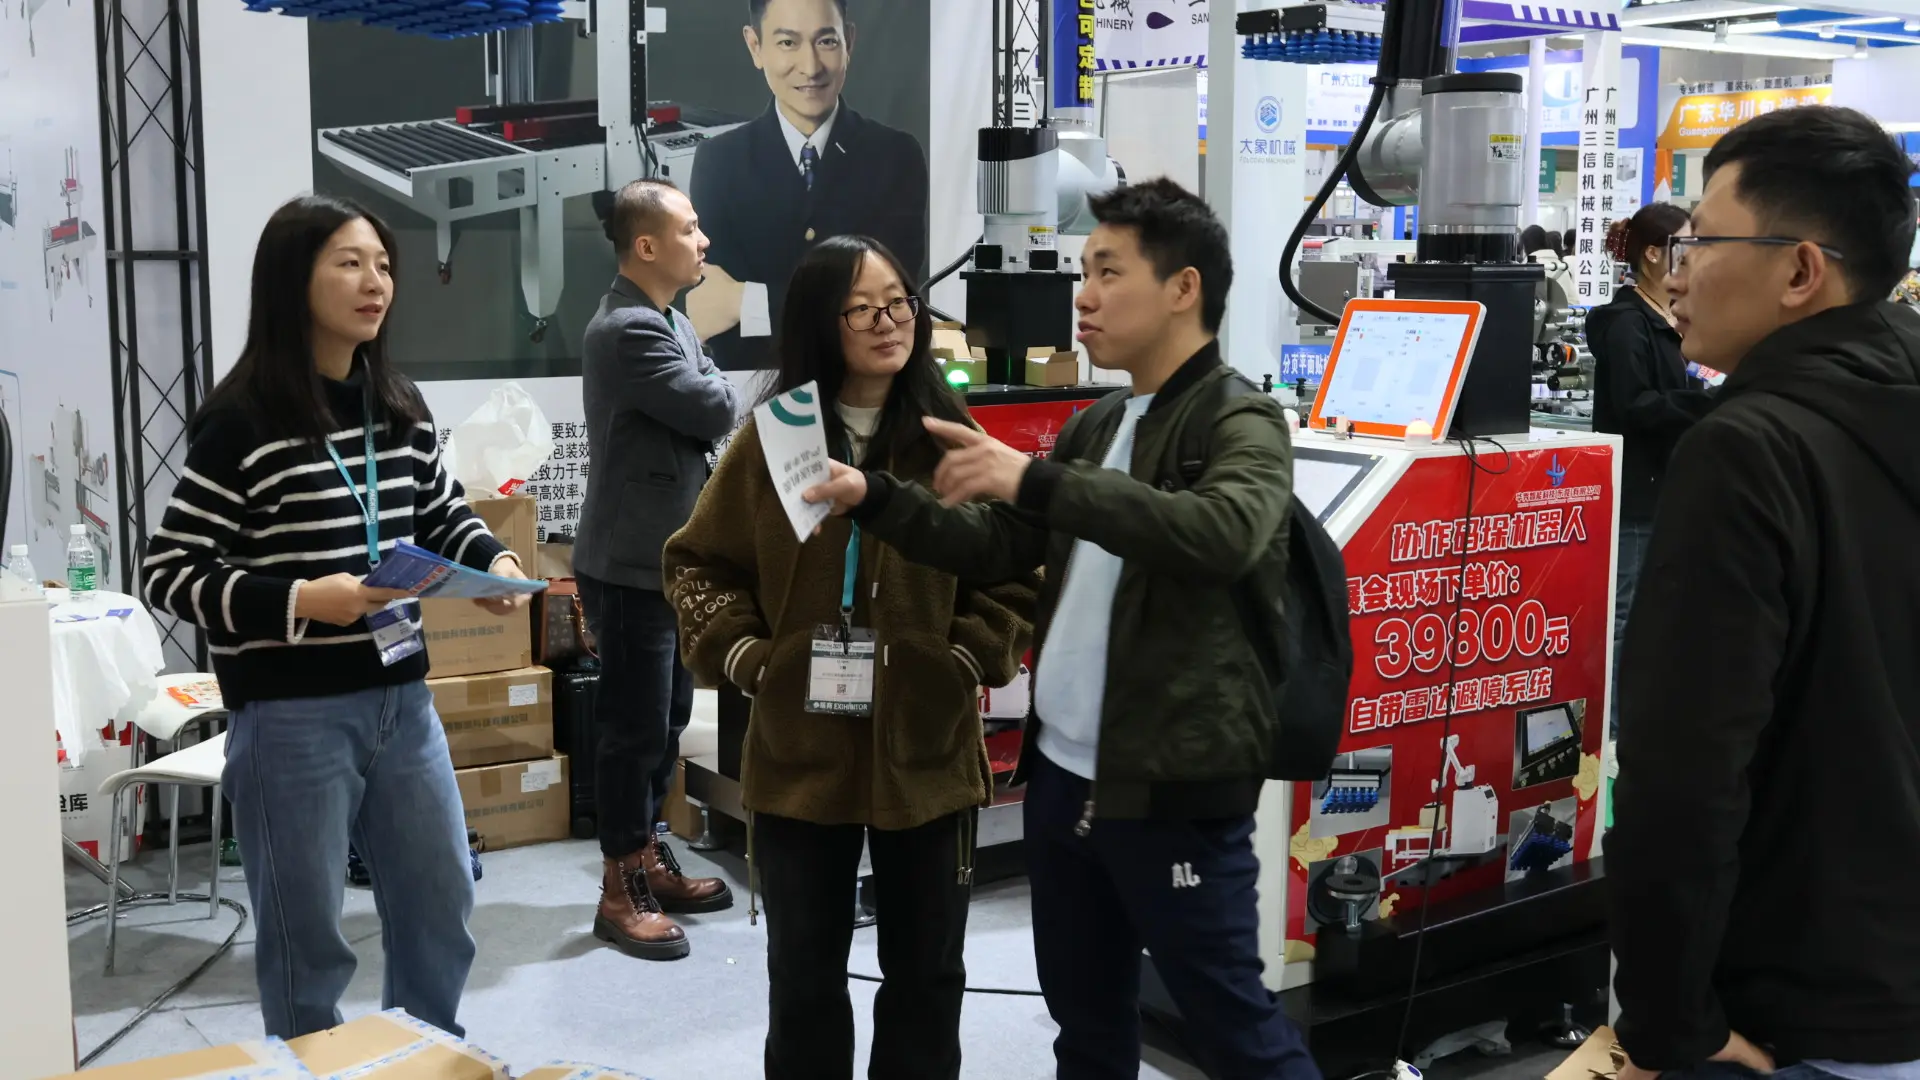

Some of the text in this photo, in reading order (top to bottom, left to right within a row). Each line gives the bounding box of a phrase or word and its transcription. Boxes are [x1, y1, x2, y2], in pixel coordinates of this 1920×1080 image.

[1096, 0, 1133, 18] 械
[1679, 94, 1833, 124] 广东华川包装设
[1239, 138, 1297, 156] 大象机械
[1578, 87, 1599, 297] 广州三信机械有限公司
[552, 422, 588, 440] 要致力
[548, 443, 590, 461] 包装效
[536, 502, 585, 522] 造最新
[560, 523, 578, 537] 我
[1391, 506, 1586, 561] 协作码垛机器人
[1350, 667, 1552, 732] 自带雷达避障系统
